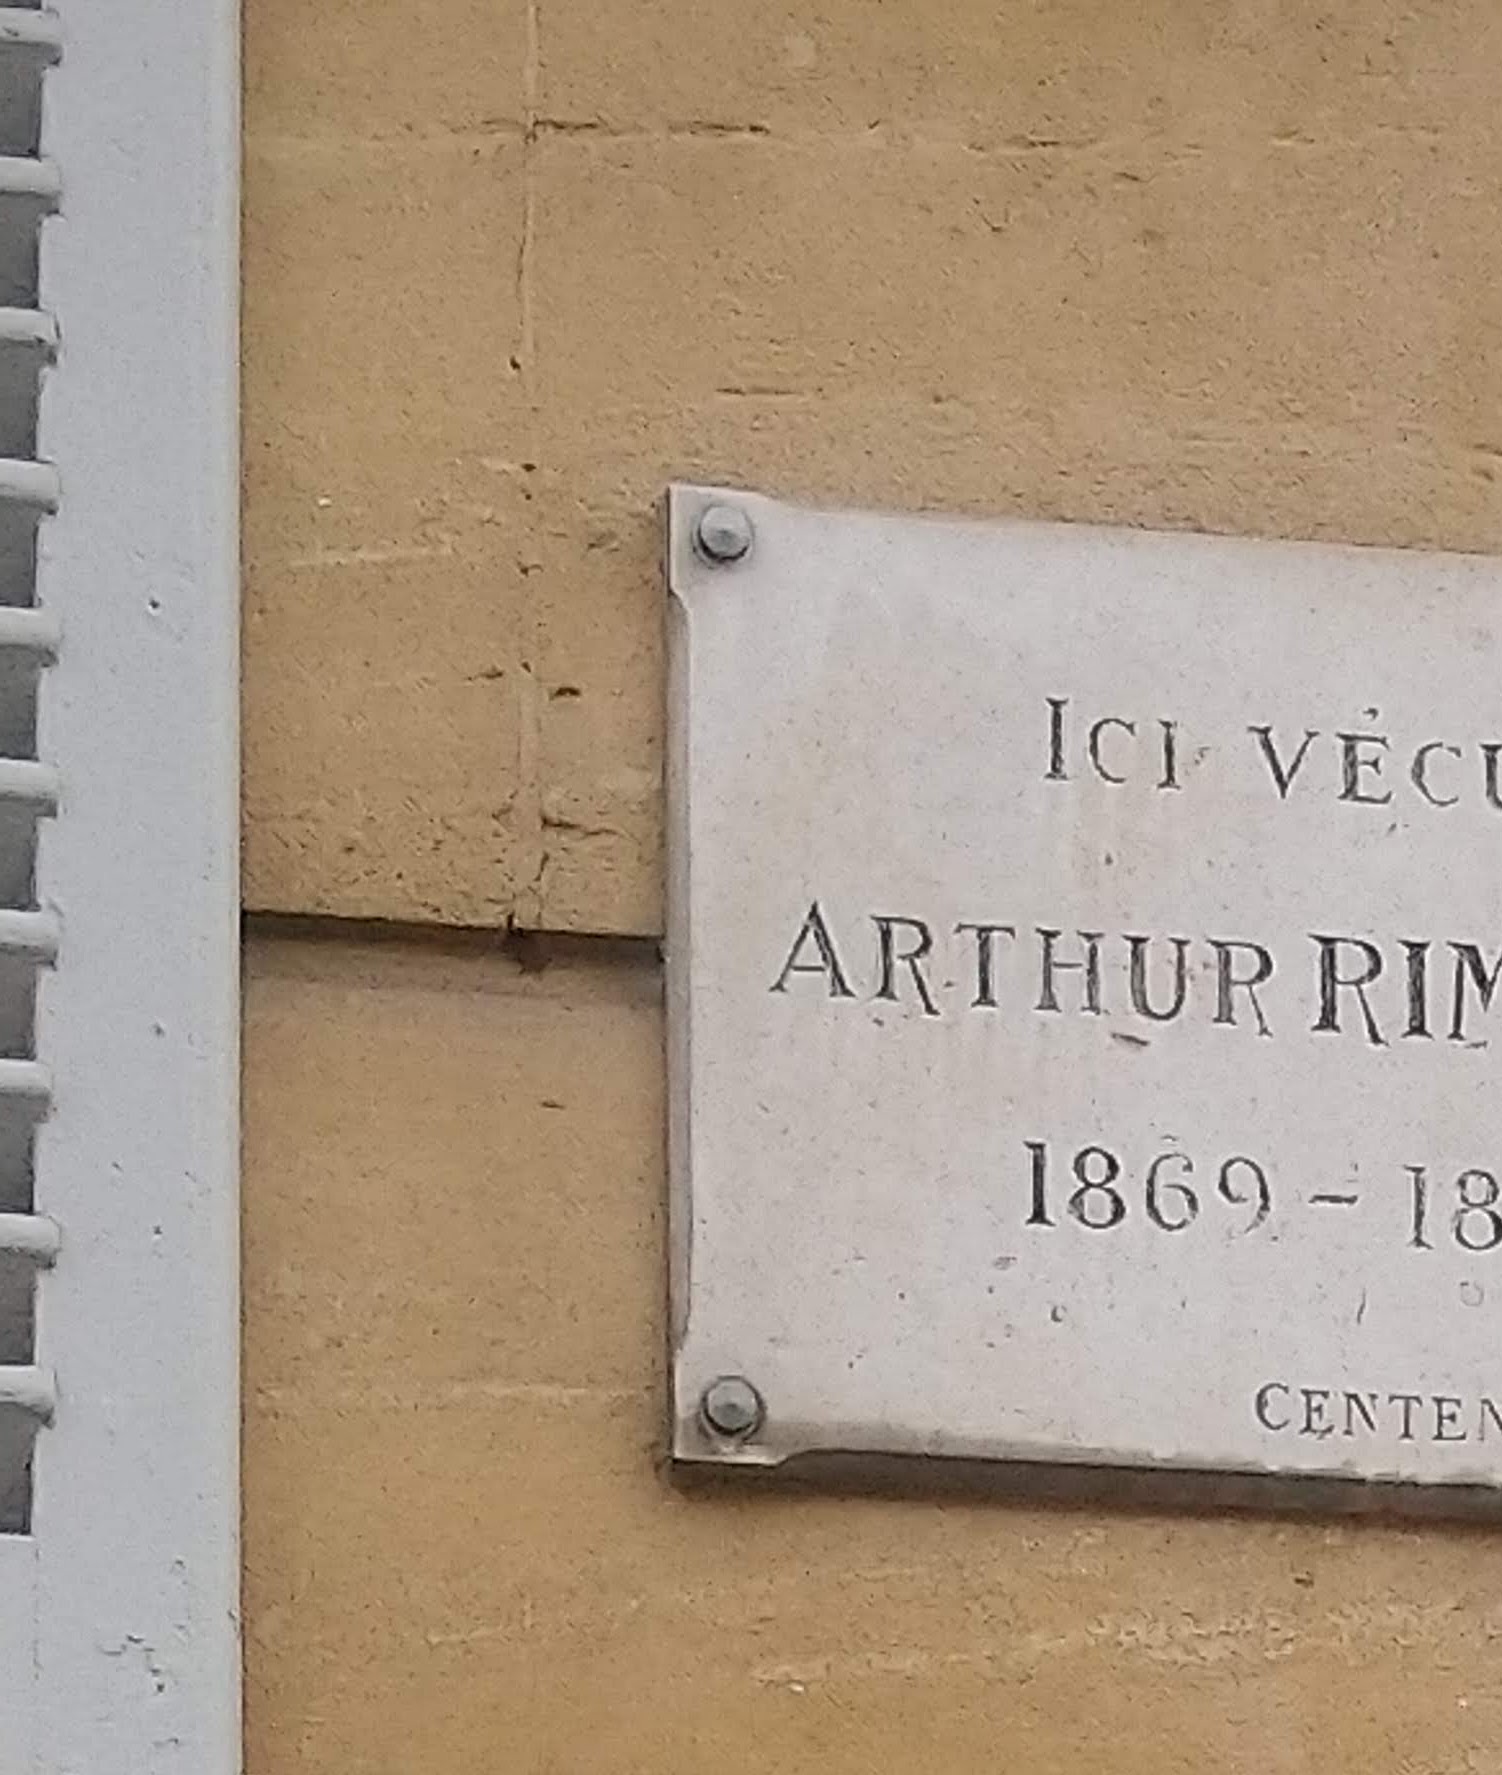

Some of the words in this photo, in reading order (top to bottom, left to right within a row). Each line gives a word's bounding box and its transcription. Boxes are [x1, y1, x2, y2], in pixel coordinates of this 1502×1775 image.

[1043, 695, 1183, 792] ICI
[767, 899, 1275, 1039] ARTHUR
[1023, 1139, 1273, 1234] 1869
